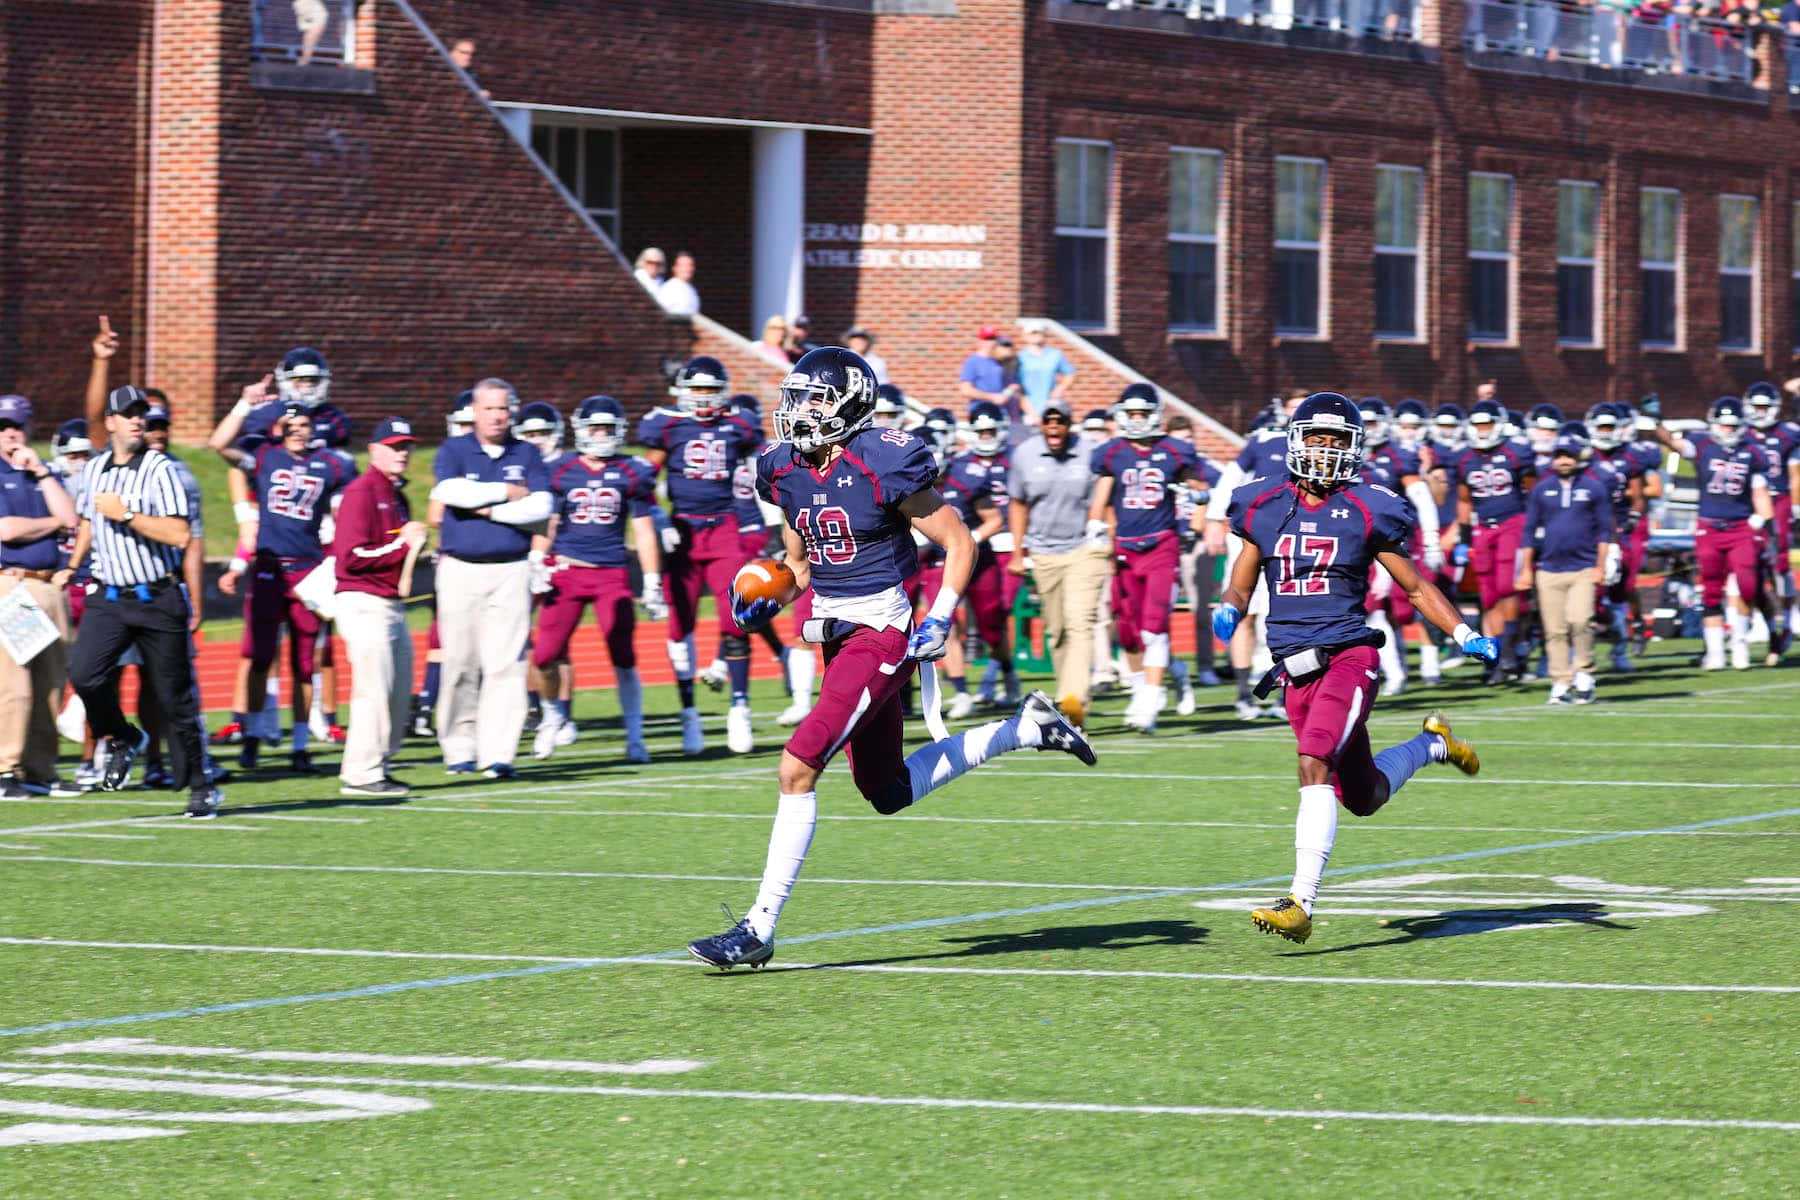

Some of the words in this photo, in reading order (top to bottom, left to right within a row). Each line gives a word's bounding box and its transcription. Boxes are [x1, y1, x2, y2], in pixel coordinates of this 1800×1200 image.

[907, 224, 987, 243] JORDAN
[901, 249, 983, 268] CENTER
[683, 440, 729, 479] 91
[268, 469, 324, 521] 27
[1121, 468, 1165, 509] 16
[796, 507, 857, 565] 19
[1274, 534, 1338, 596] 17
